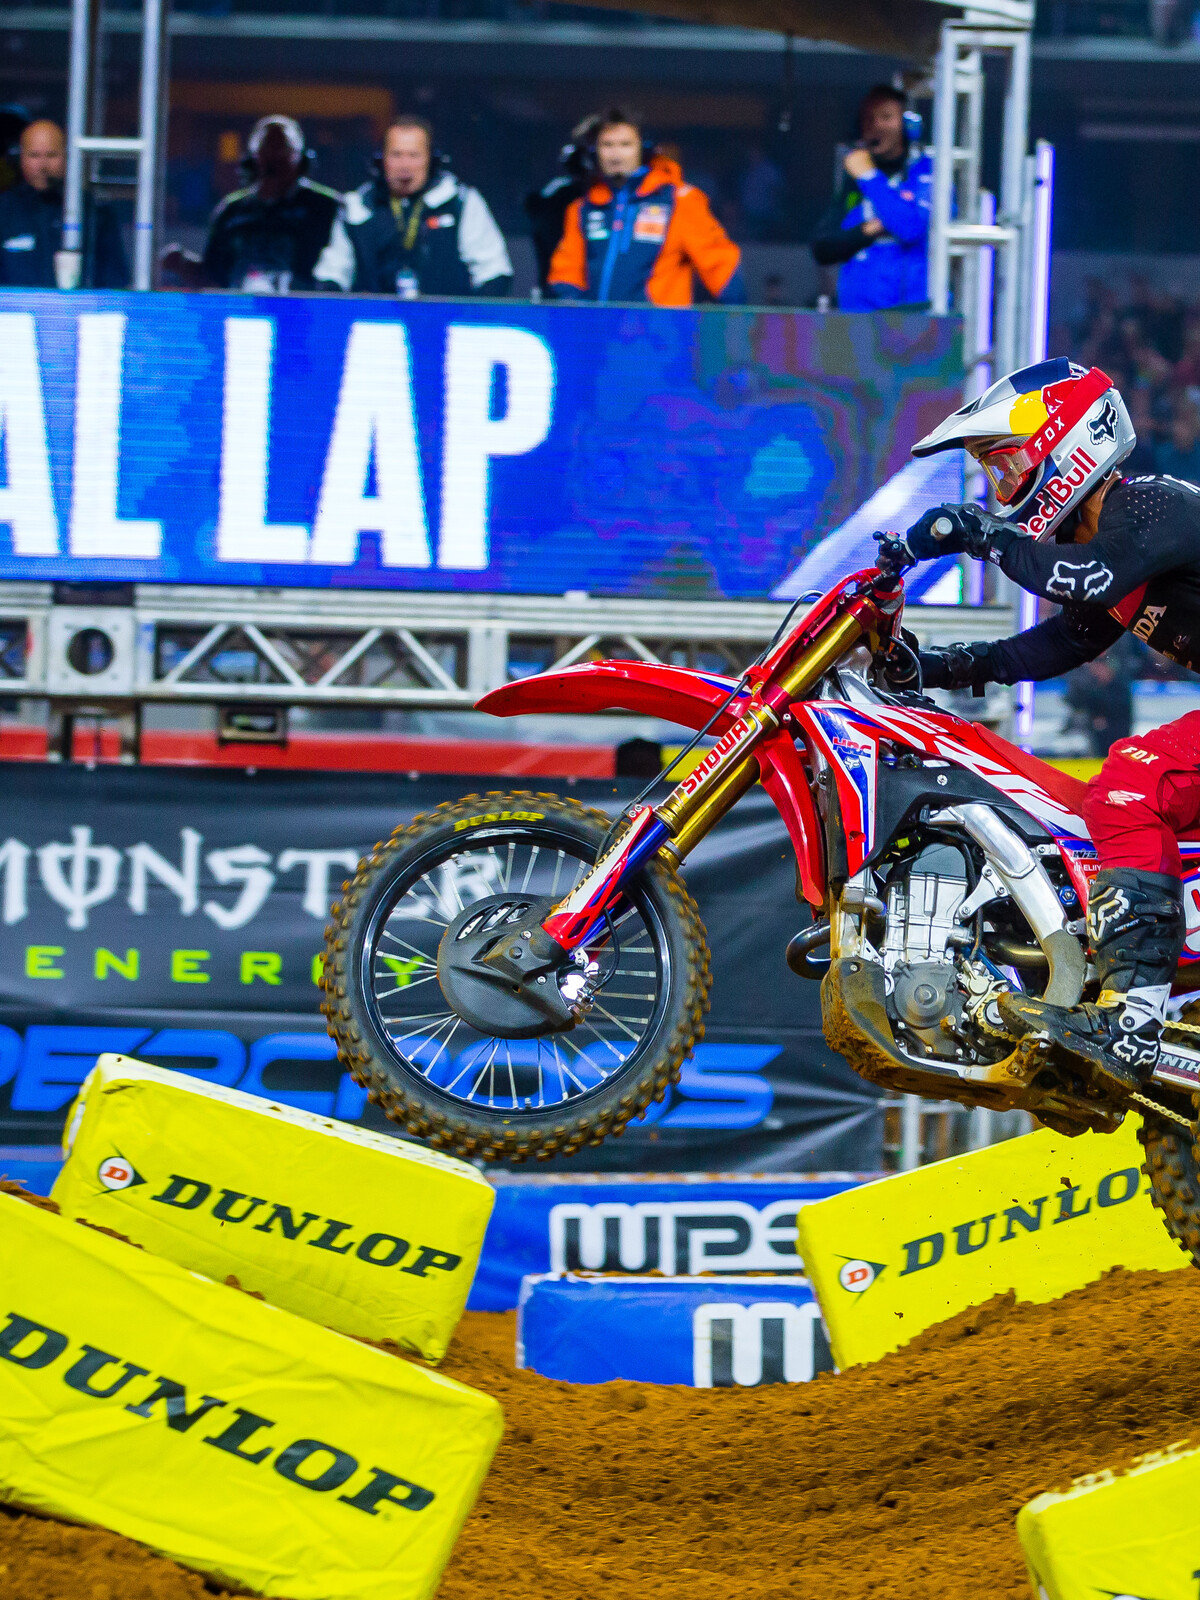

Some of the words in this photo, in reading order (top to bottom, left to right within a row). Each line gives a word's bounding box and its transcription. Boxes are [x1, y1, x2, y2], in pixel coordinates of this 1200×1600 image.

[217, 316, 554, 569] LAP
[1034, 416, 1065, 452] FOX
[1047, 446, 1098, 505] Bull
[681, 718, 750, 796] SHOWA
[832, 736, 872, 759] HRC
[1120, 746, 1159, 765] FOX
[454, 811, 545, 832] DUNLOP
[25, 945, 427, 988] ENERY
[151, 1173, 462, 1279] DUNLOP
[899, 1166, 1152, 1277] DUNLO
[0, 1311, 436, 1516] DUNLOP
